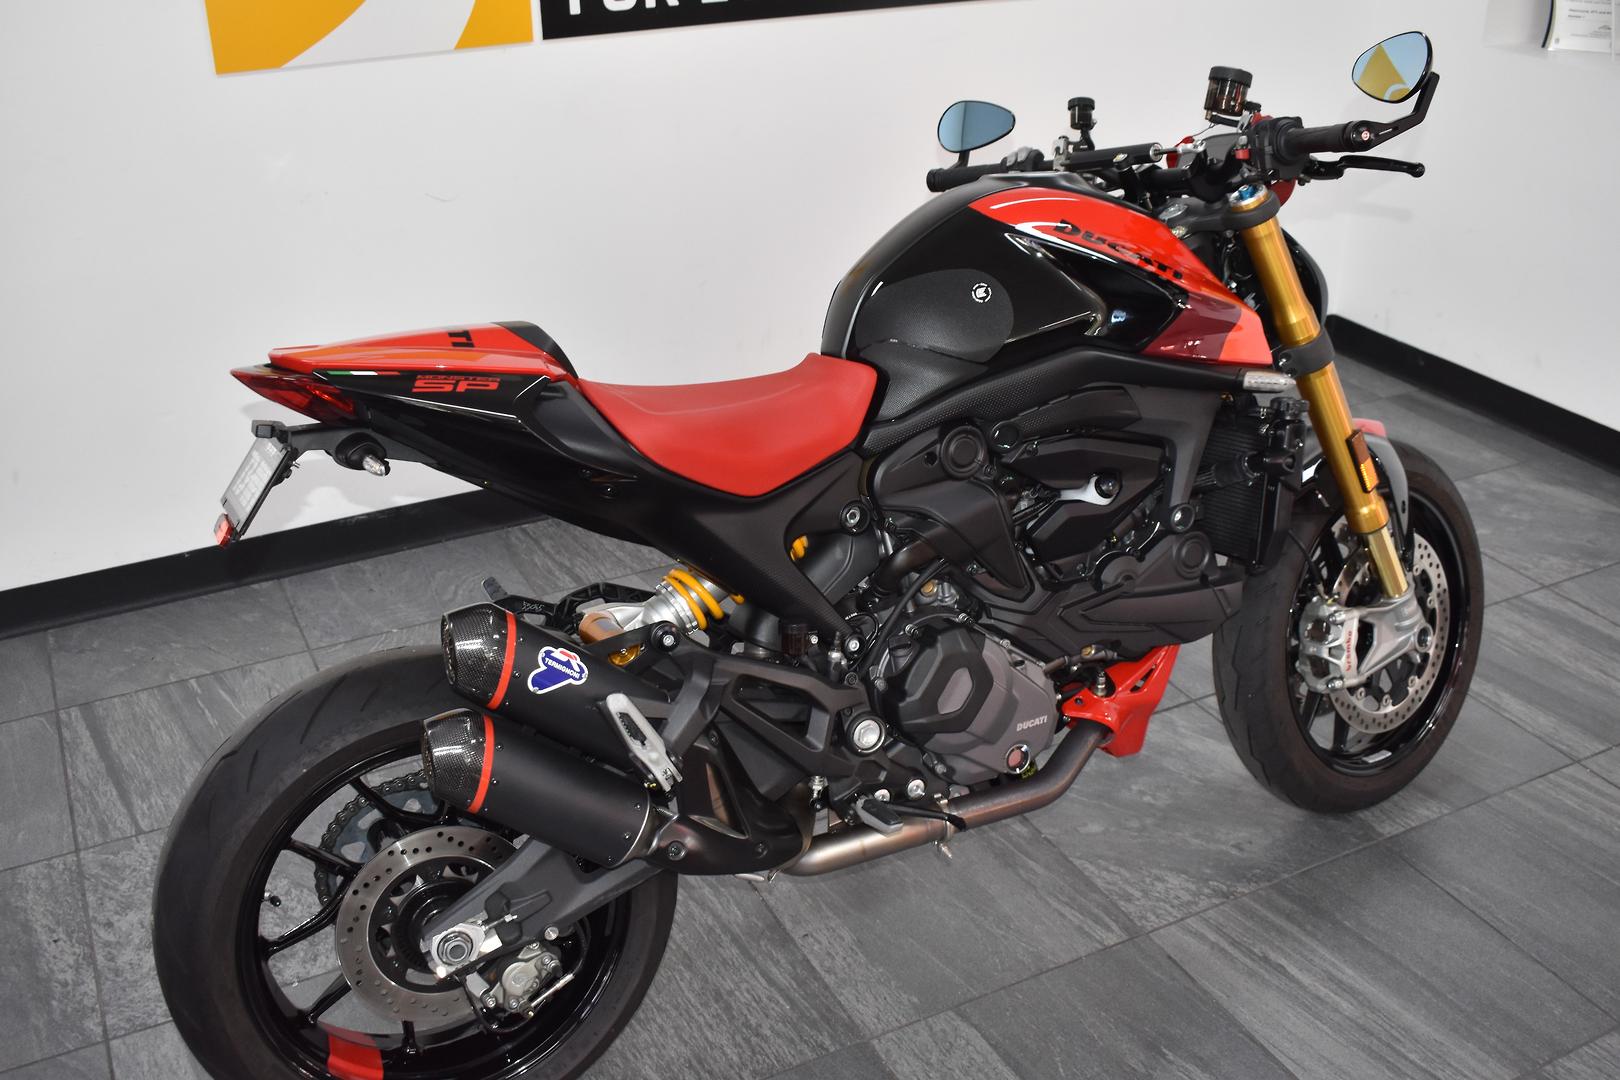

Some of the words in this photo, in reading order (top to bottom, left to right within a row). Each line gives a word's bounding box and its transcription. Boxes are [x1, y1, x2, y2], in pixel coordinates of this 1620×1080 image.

[411, 379, 499, 393] SP
[544, 658, 581, 679] TERMIGNONI
[1016, 715, 1048, 732] DUCATI
